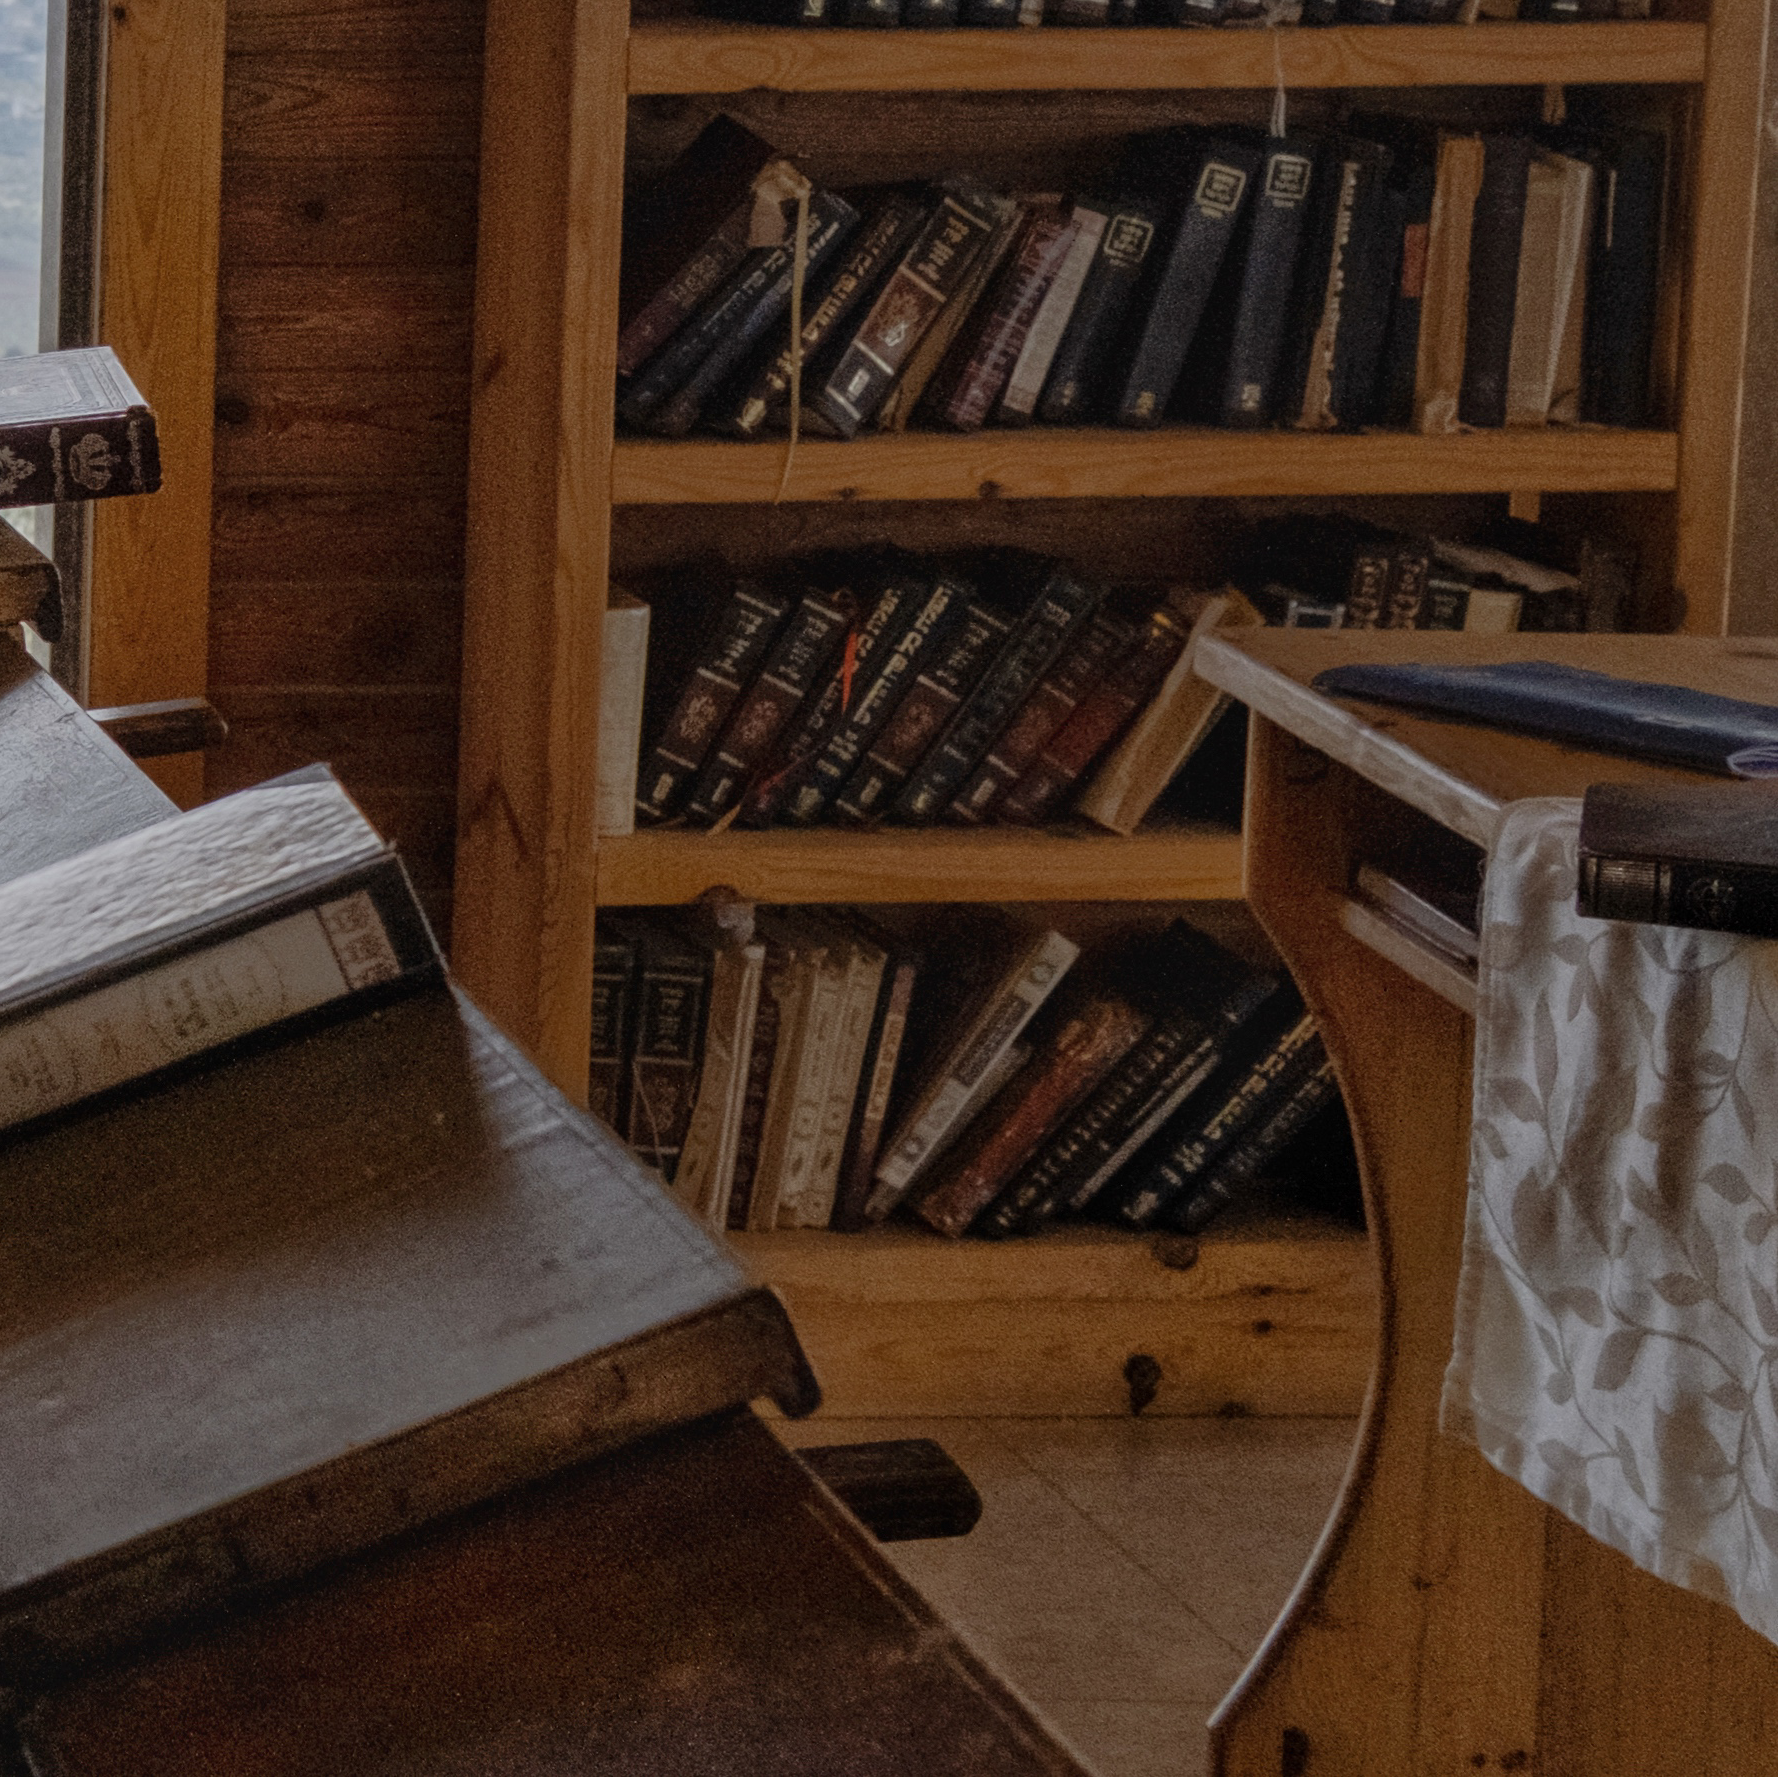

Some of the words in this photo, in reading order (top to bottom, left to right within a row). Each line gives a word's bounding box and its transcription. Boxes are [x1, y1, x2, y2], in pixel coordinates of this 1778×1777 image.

[834, 273, 857, 298] פה
[803, 296, 841, 343] החדש
[914, 585, 952, 633] תפלת
[896, 627, 923, 656] כל
[883, 652, 908, 681] פה
[854, 678, 891, 727] החדש
[1254, 1050, 1284, 1081] כל
